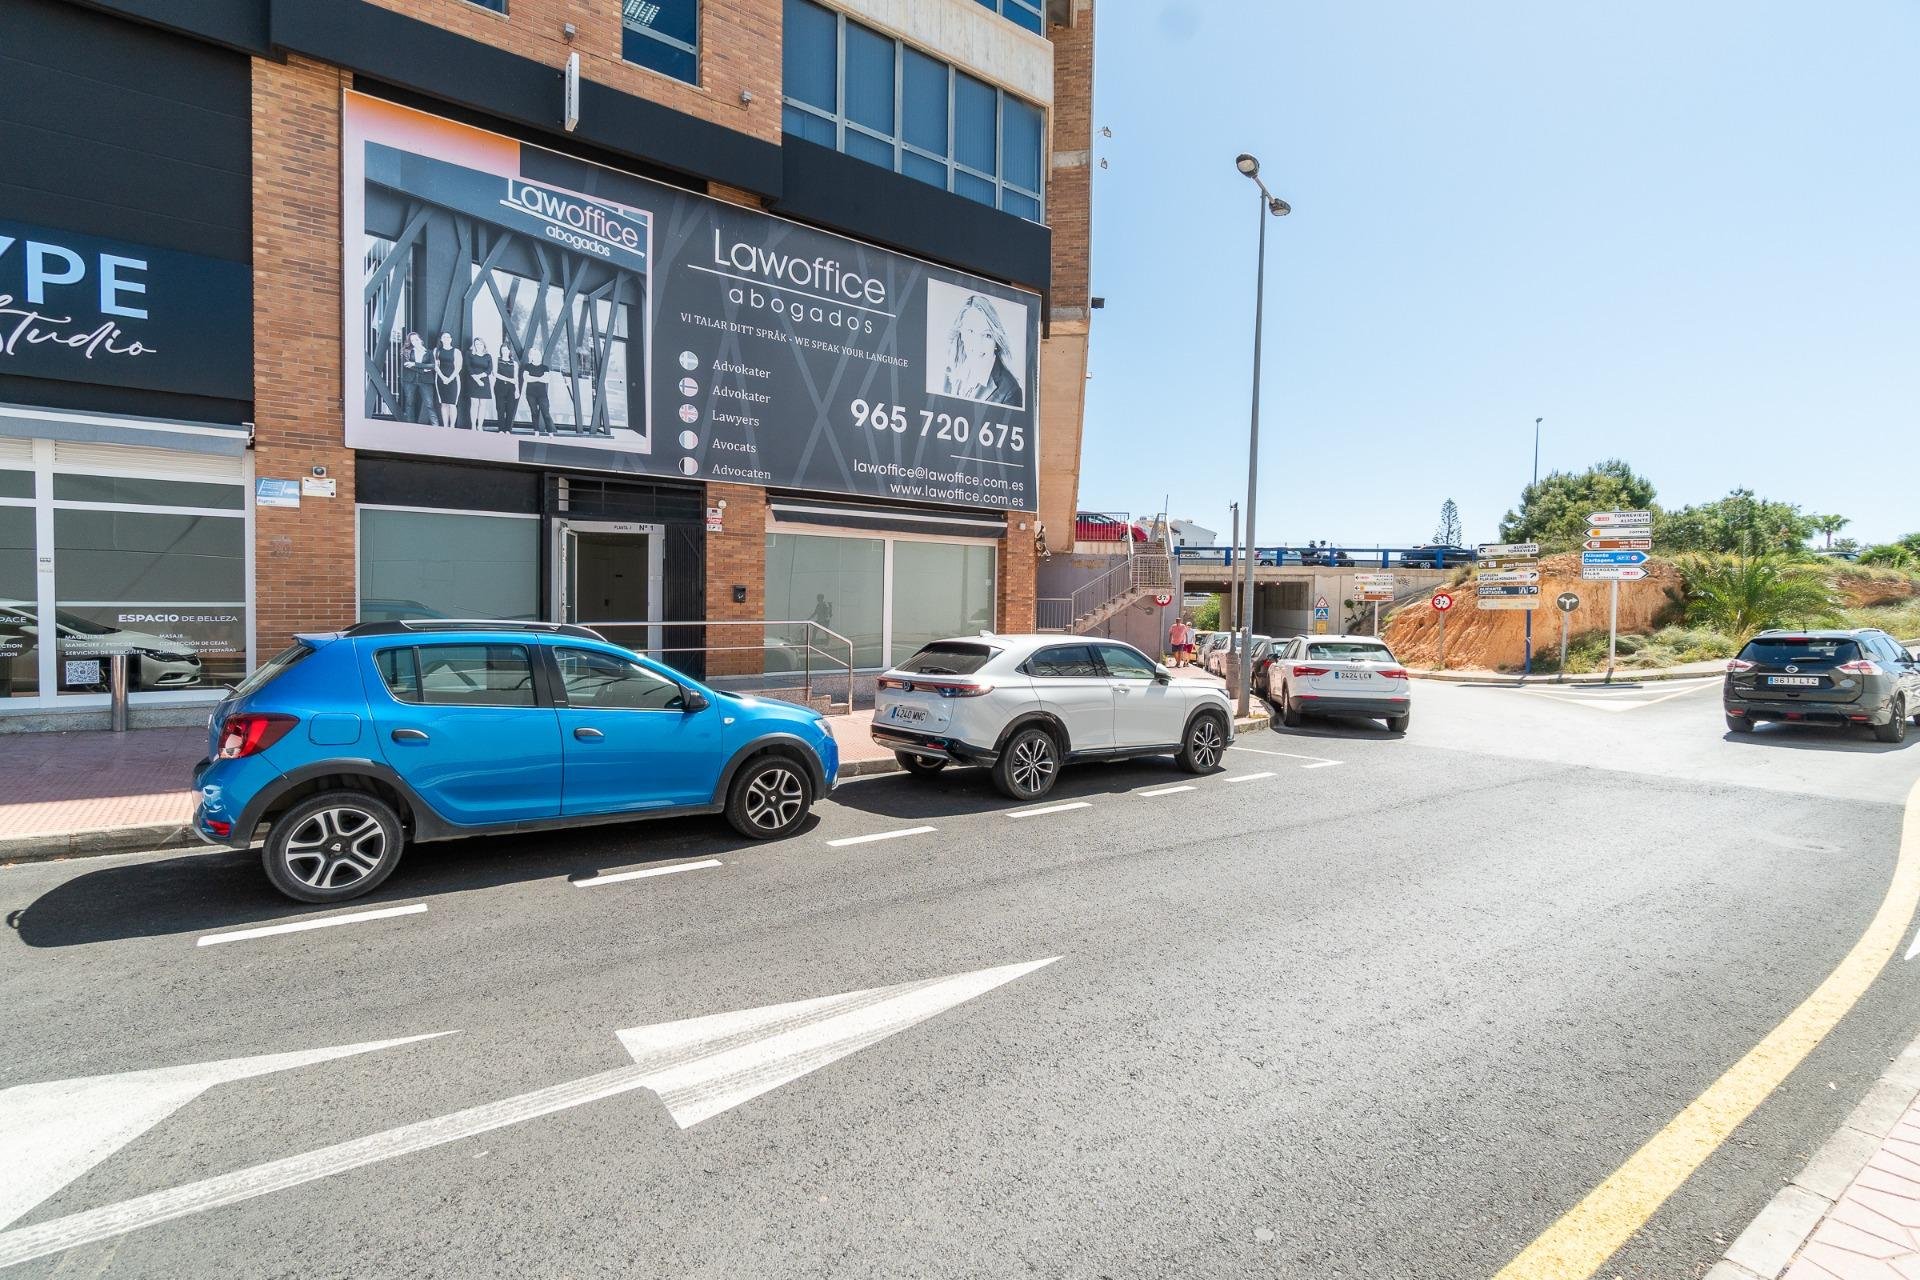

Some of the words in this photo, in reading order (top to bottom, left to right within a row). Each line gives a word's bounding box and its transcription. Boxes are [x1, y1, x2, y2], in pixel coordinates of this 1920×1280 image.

[508, 178, 639, 248] Lawoffice
[546, 225, 611, 257] abogados
[714, 228, 886, 304] Lawoffice
[728, 288, 873, 334] abogados
[680, 312, 692, 323] VI
[694, 314, 728, 330] TALAR
[730, 322, 754, 335] DITT
[755, 328, 787, 342] SPRÅK
[794, 336, 810, 347] WE
[811, 340, 840, 354] SPEAK
[841, 345, 865, 359] YOUR
[866, 351, 909, 368] LANGUAGE
[712, 359, 771, 379] Advokater
[712, 385, 771, 404] Advokater
[712, 409, 760, 427] Lawyers
[850, 398, 908, 434] 965
[919, 410, 969, 443] 720
[978, 421, 1025, 451] 675
[712, 438, 757, 454] Avocats
[712, 463, 771, 480] Advocaten
[853, 459, 1024, 492] lawoffice@lawoffice.com.es
[890, 483, 1024, 507] www.lawoffice.com.es
[118, 614, 180, 622] ESPACIO
